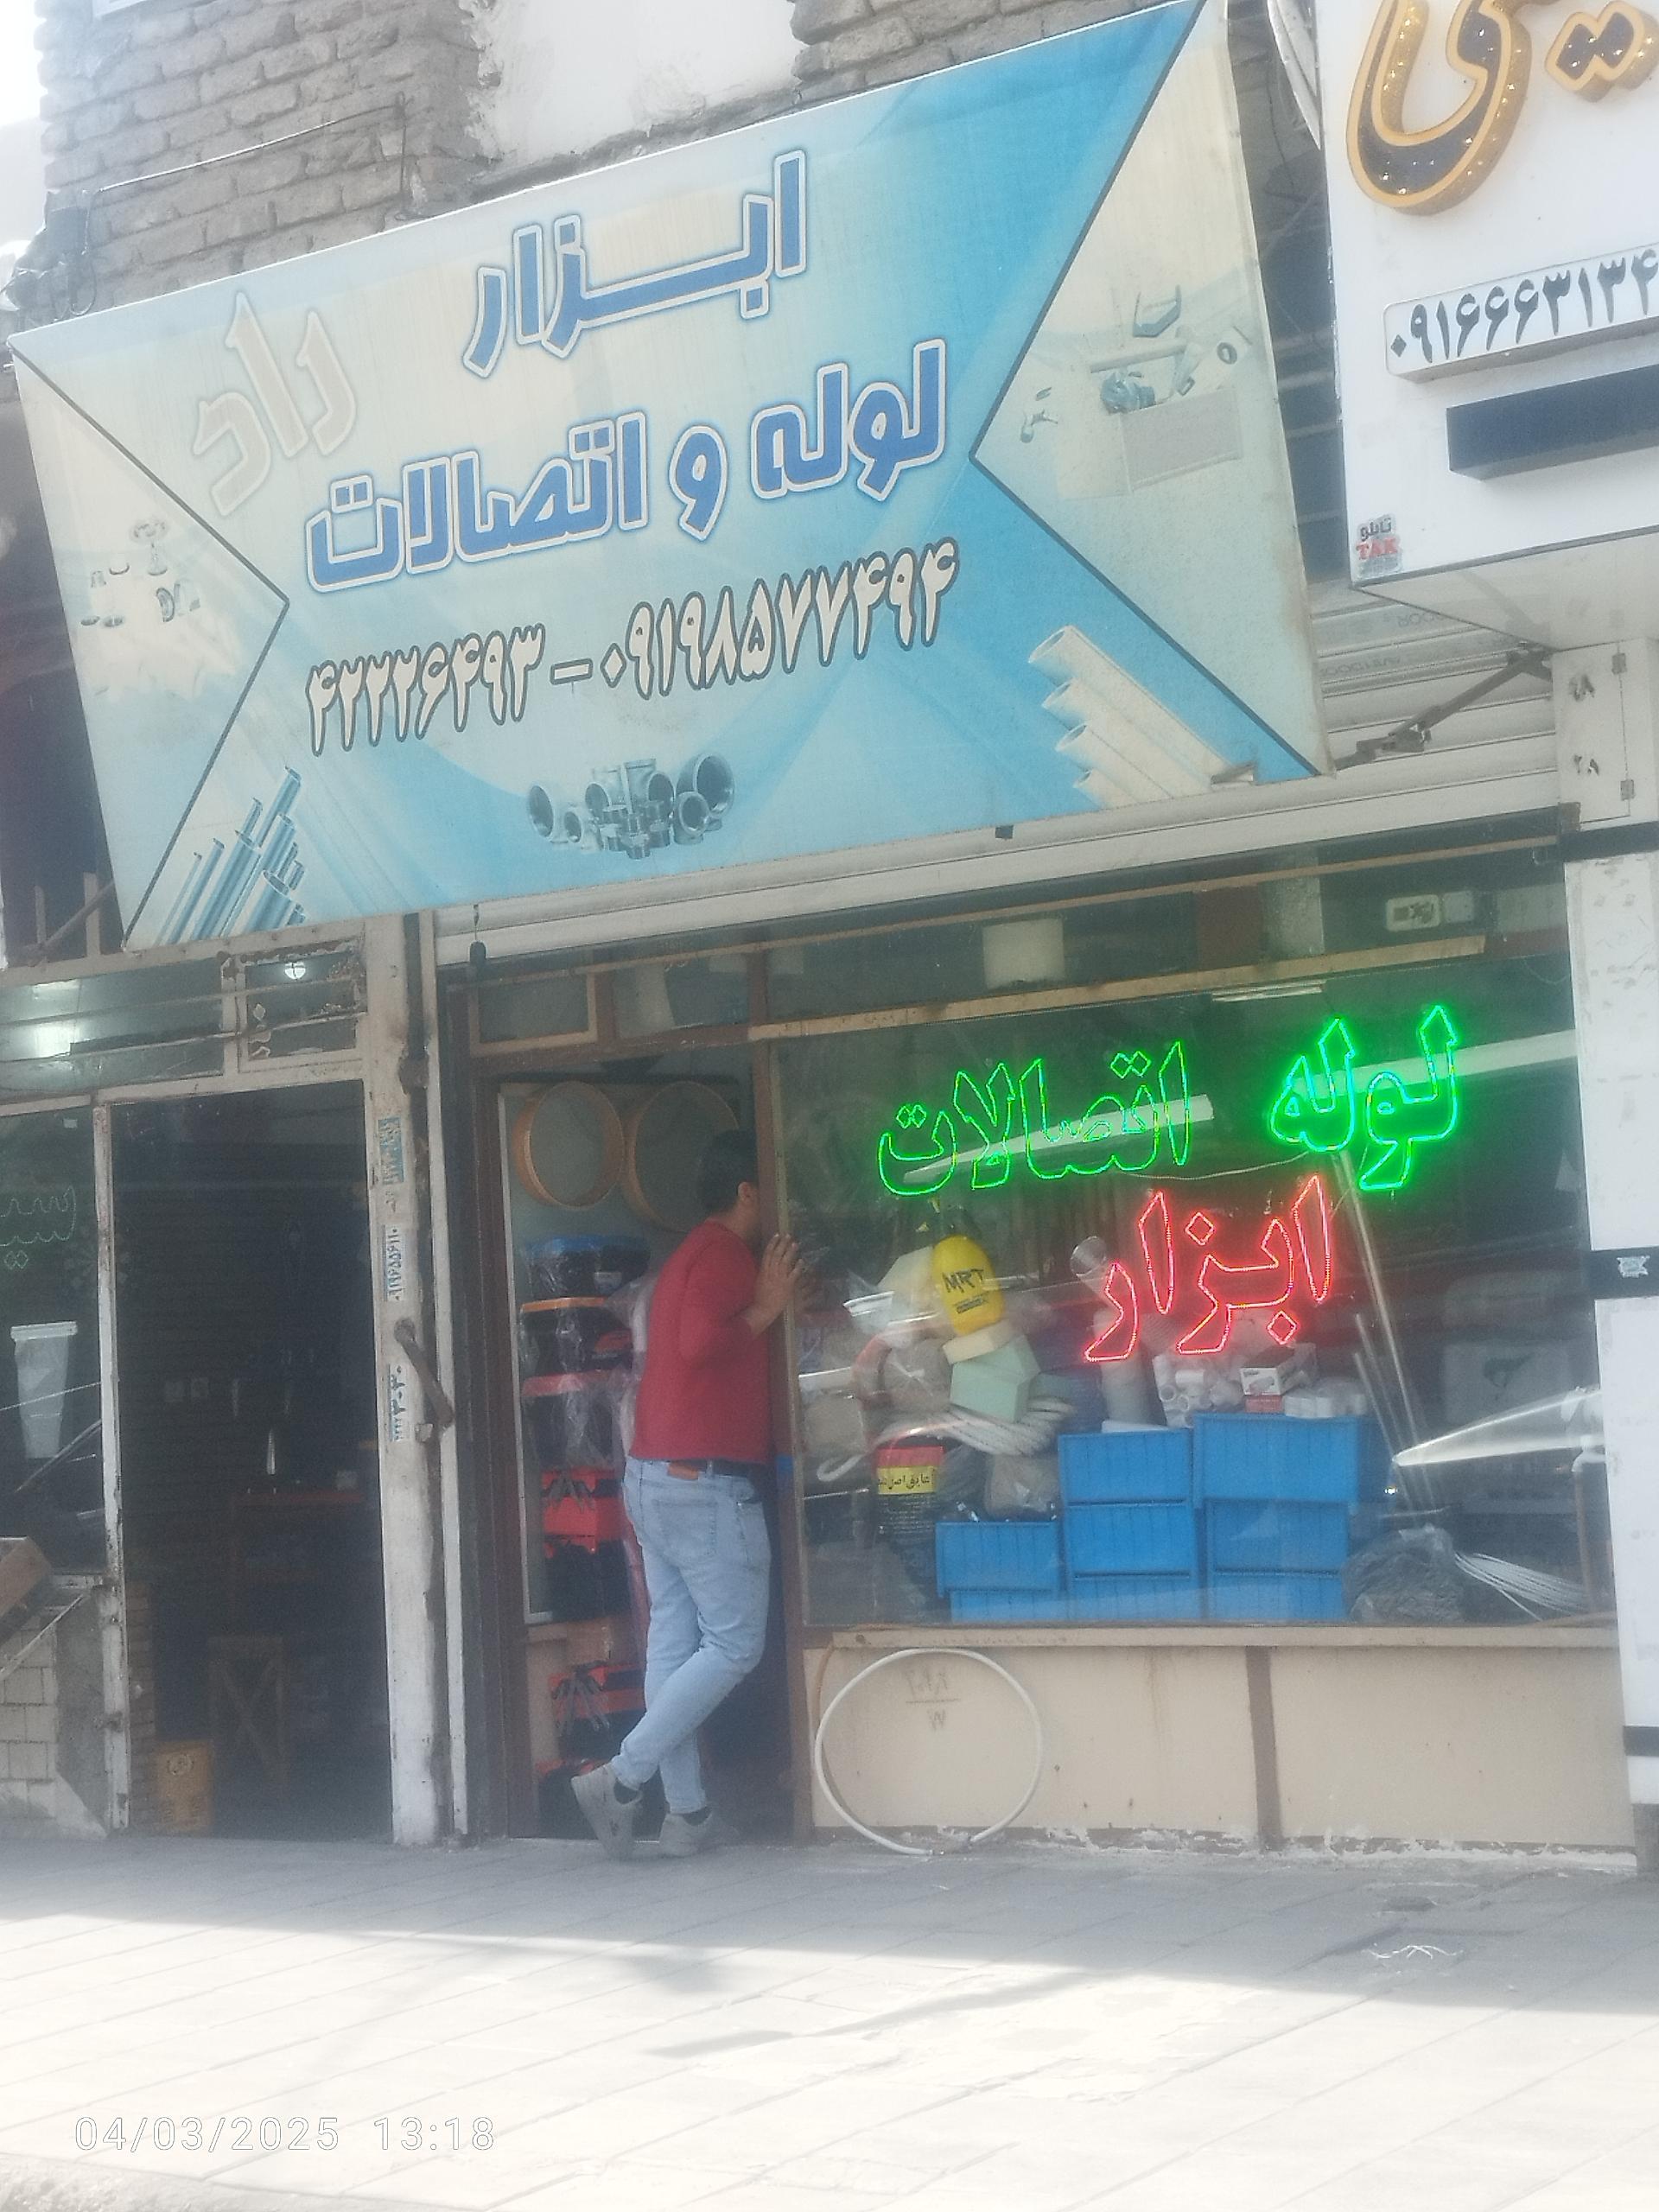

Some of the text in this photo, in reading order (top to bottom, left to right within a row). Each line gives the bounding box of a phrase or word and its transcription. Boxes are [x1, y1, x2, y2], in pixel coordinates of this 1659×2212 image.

[462, 149, 806, 378] ابزار
[193, 291, 357, 518] راد
[304, 337, 946, 593] لوله و اتصالات
[600, 537, 960, 701] ۰۹۱۹۸۵۷۷۴۹۴
[1356, 537, 1398, 560] TAK
[305, 622, 546, 758] ۴۲۲۲۶۴۹۳
[878, 1004, 1458, 1196] لوله اتصالات
[942, 1268, 984, 1294] MRT
[1084, 1174, 1332, 1363] ابزار
